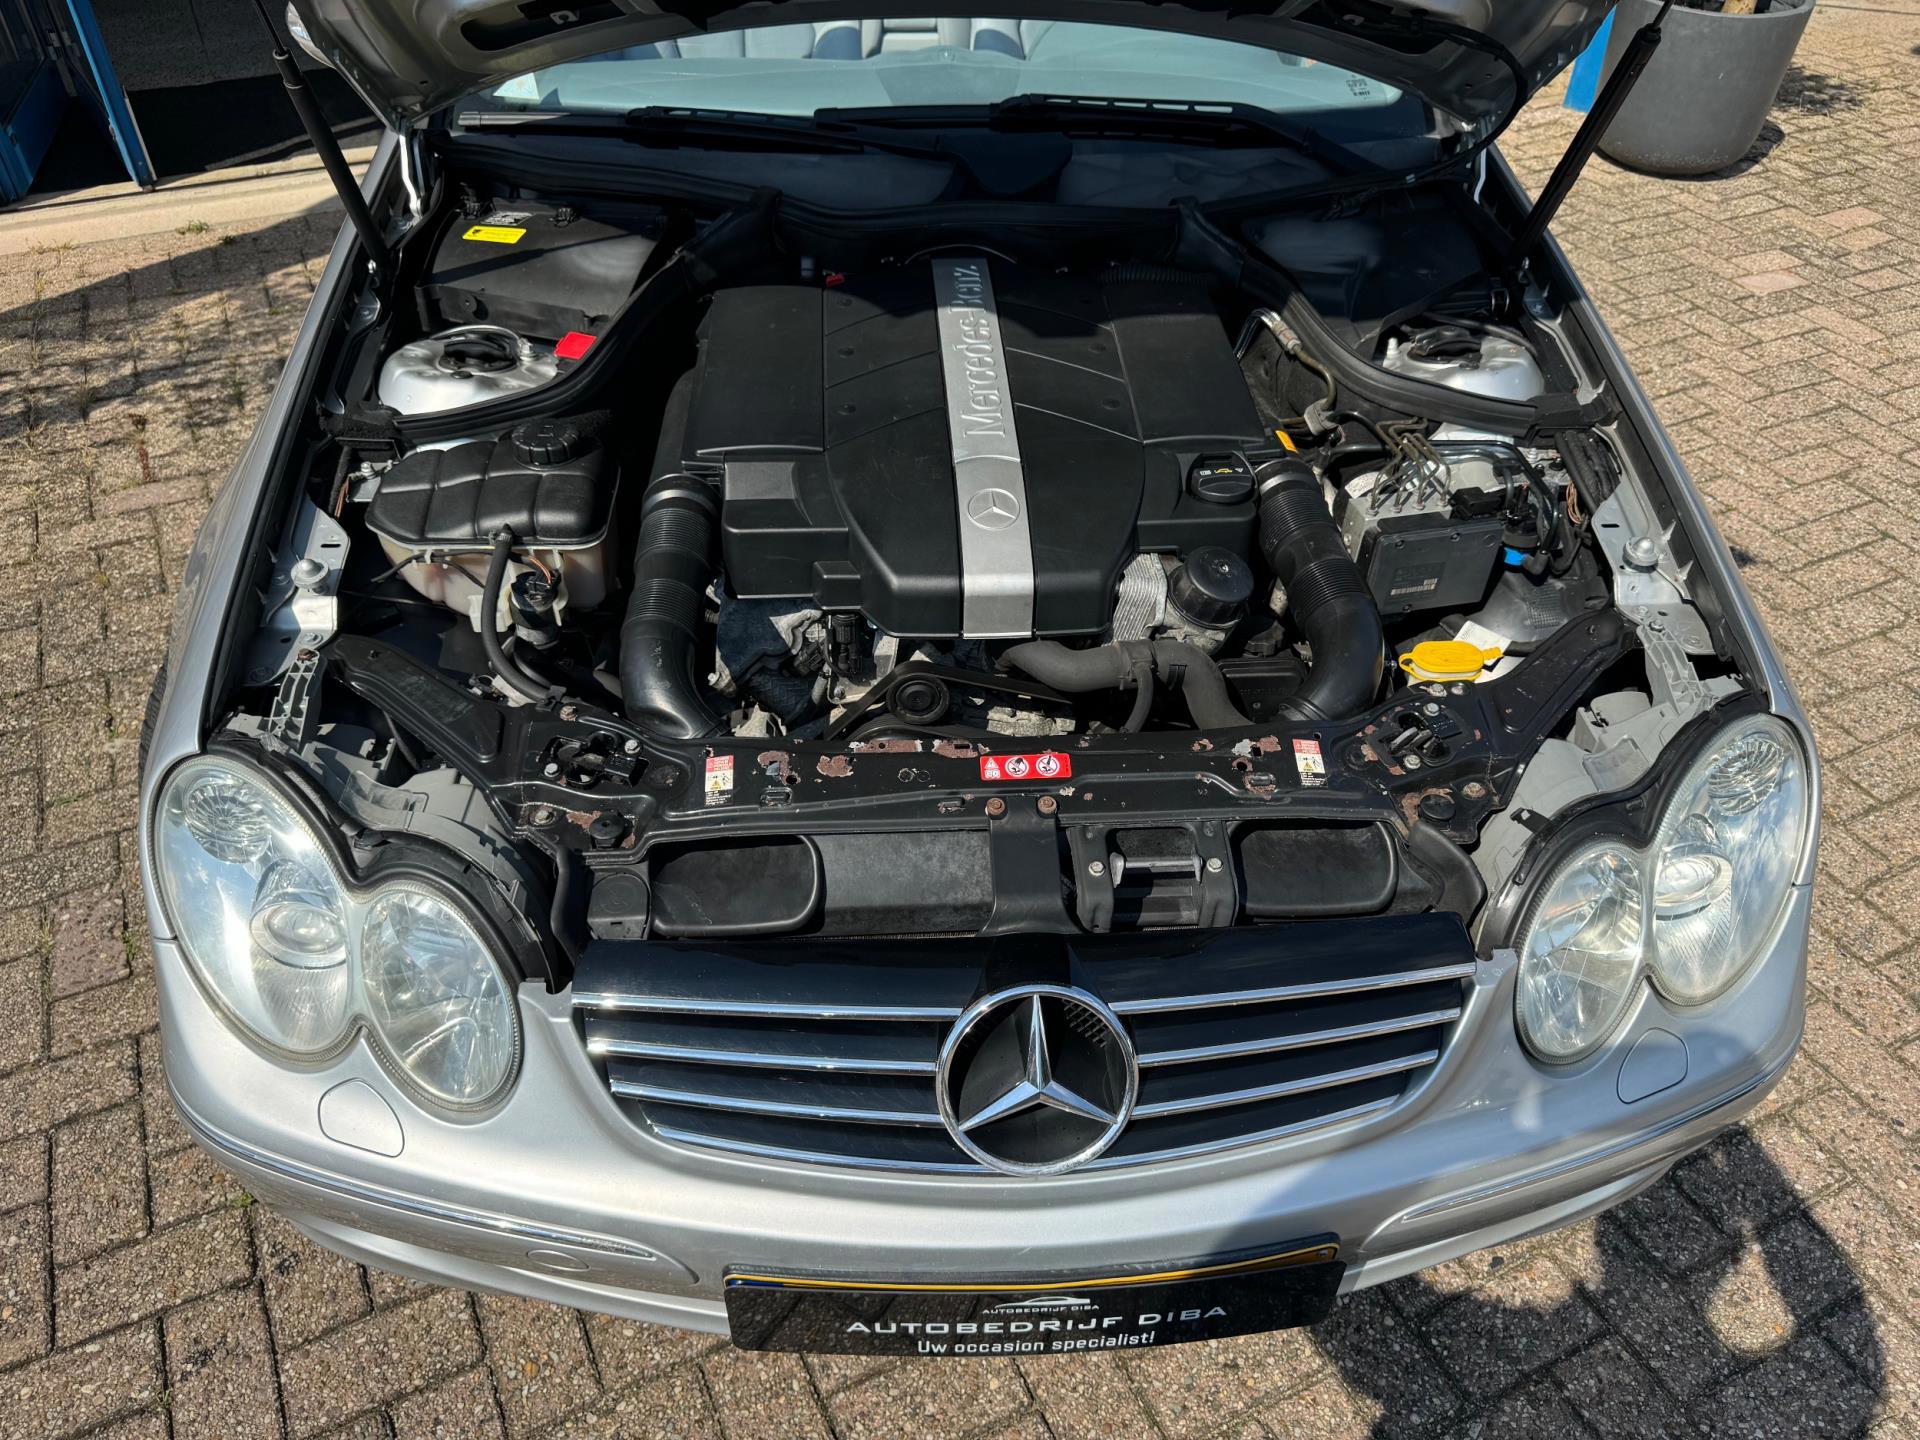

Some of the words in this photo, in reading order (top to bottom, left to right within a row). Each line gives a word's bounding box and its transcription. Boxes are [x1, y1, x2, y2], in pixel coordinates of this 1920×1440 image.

[949, 264, 1006, 439] Mercedes-Benz
[846, 1315, 1124, 1335] AUTOBEDRIJF
[1138, 1306, 1227, 1326] DIBA
[982, 1305, 1067, 1315] AUTOBEDRIJF
[1071, 1304, 1100, 1312] DIBA
[917, 1340, 948, 1354] Uw
[954, 1339, 1044, 1354] occasion
[1051, 1330, 1156, 1352] specialist!
